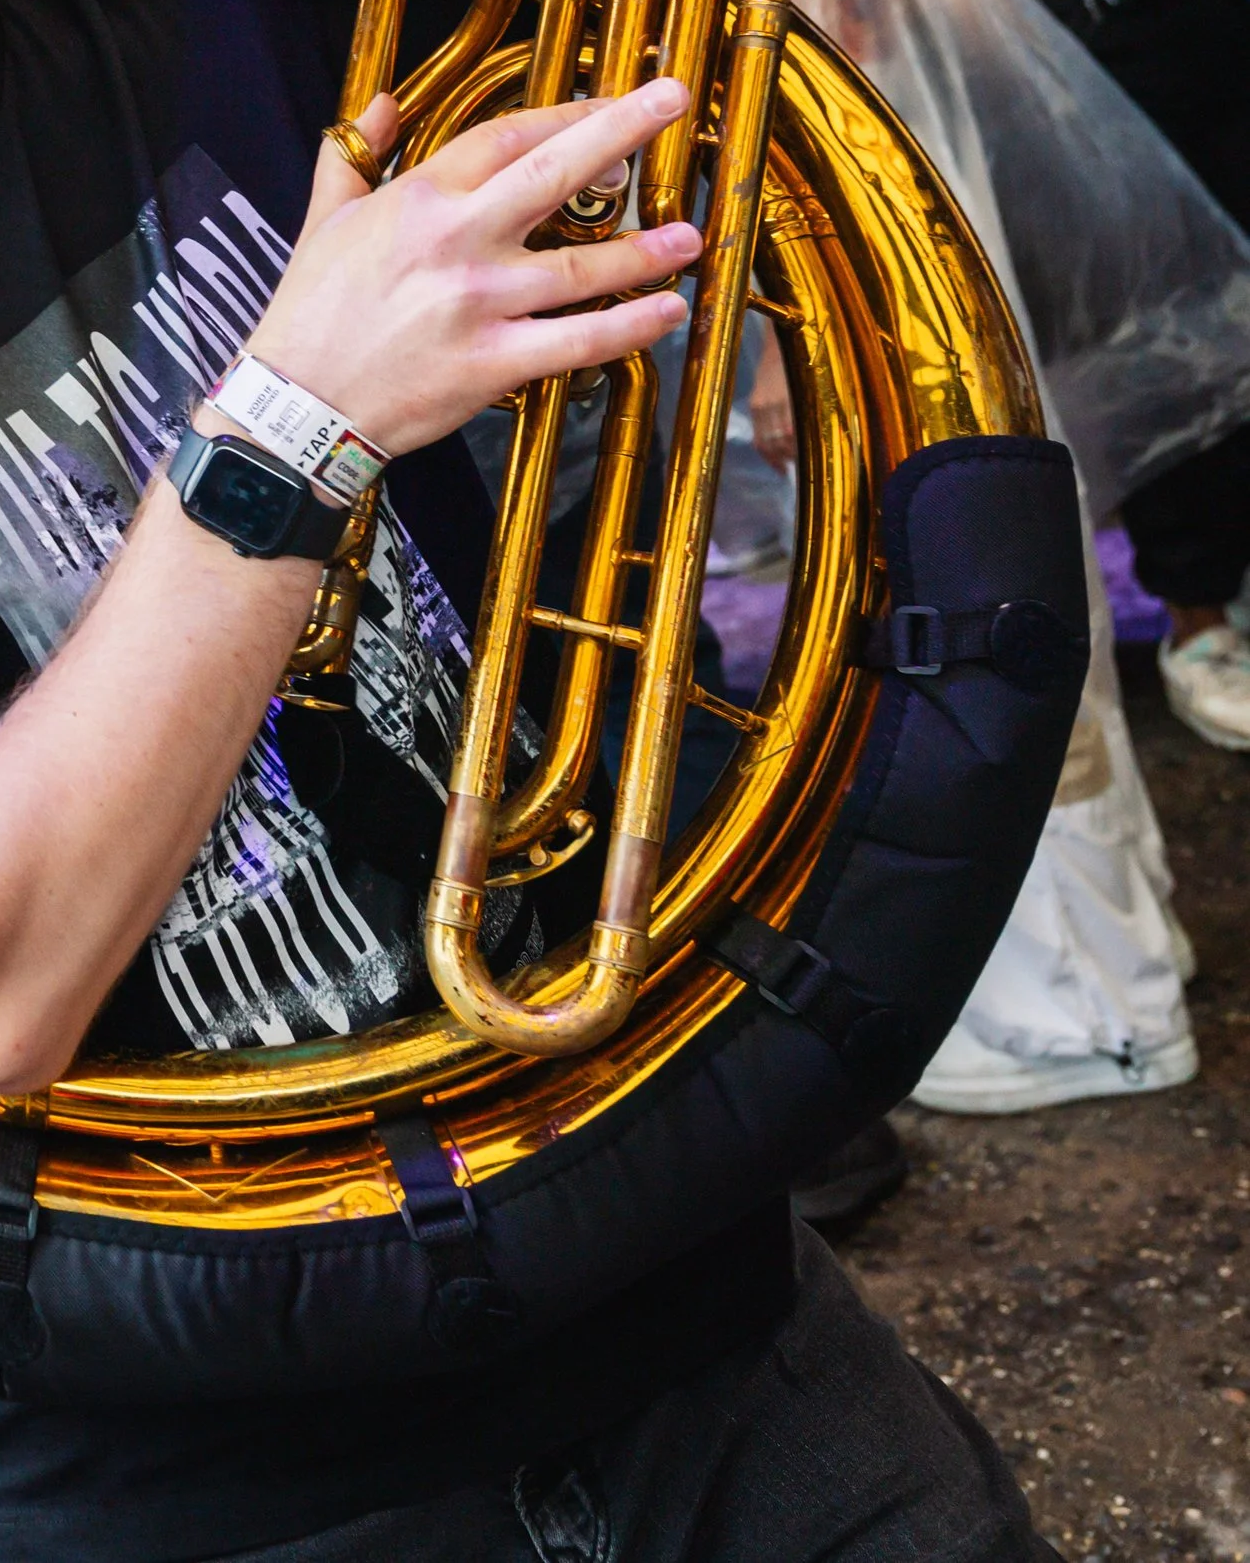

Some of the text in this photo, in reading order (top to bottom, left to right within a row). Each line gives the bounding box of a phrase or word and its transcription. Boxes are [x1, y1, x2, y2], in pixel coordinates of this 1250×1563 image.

[247, 384, 272, 416] VOID IF
[253, 389, 280, 421] REMOVED
[300, 427, 330, 461] TAP
